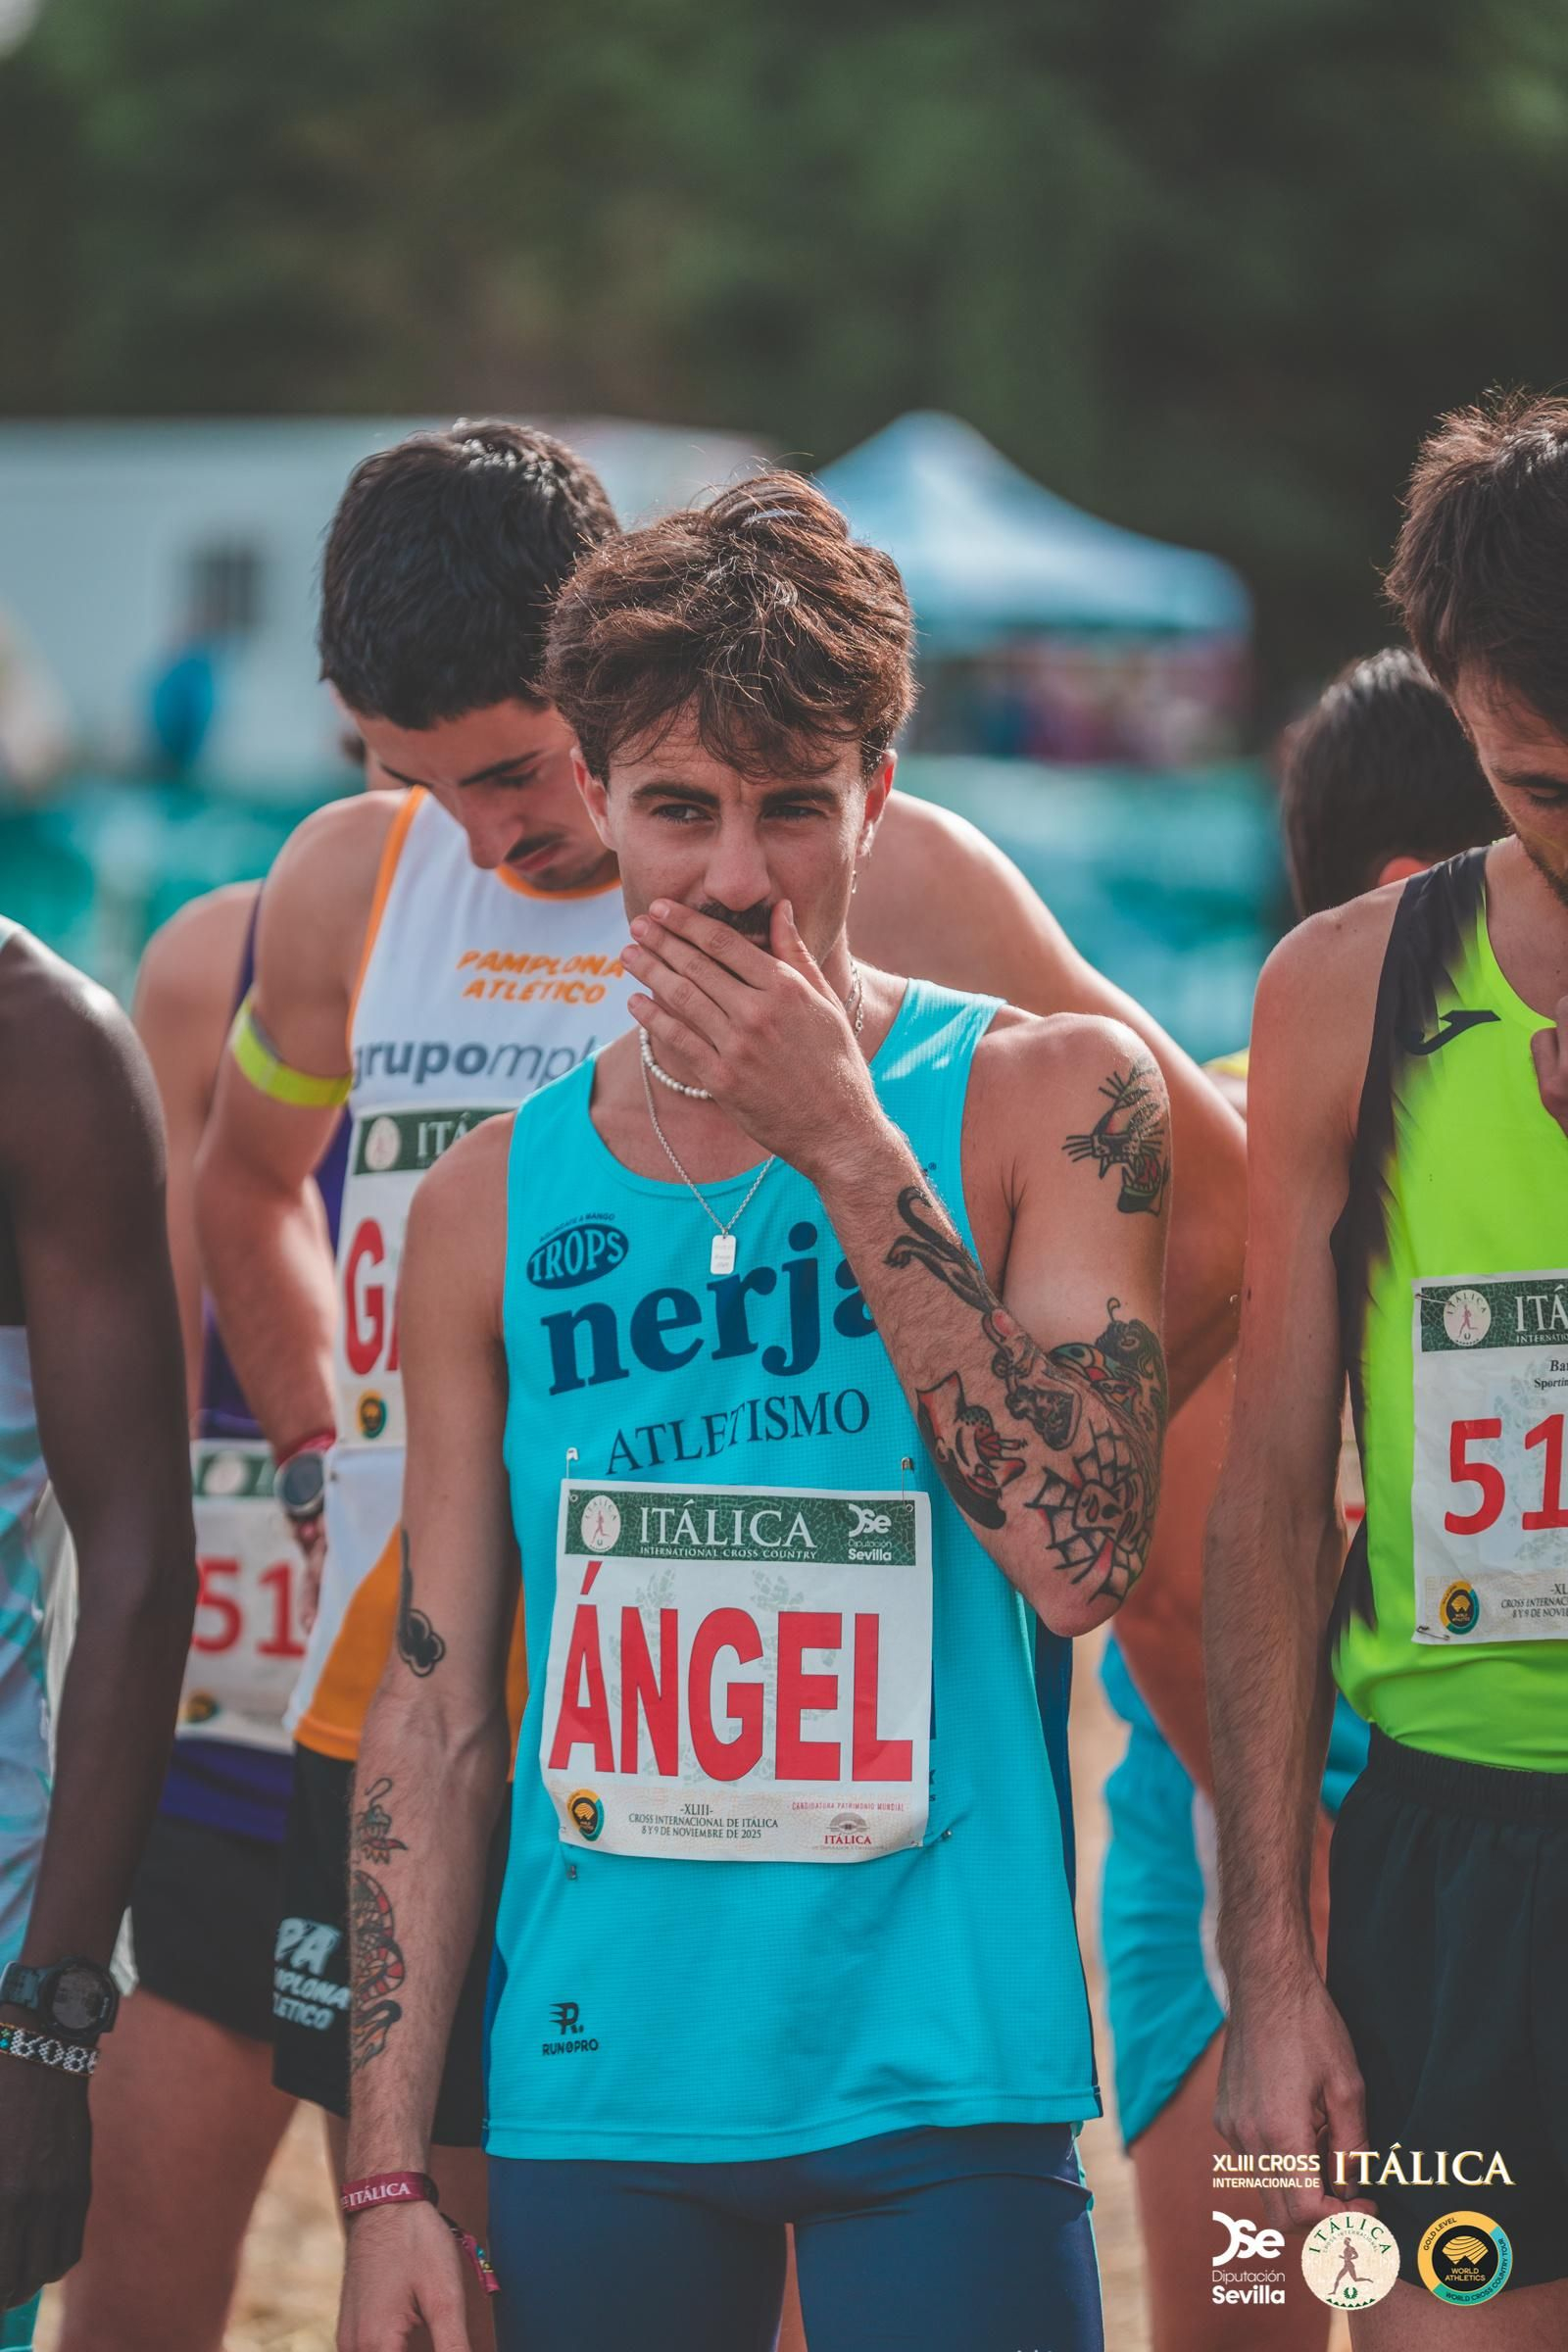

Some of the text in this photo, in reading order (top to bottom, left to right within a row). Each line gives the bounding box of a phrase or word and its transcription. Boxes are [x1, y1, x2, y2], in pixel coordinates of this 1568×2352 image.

[457, 950, 625, 978] PAMPLONA
[532, 1229, 624, 1281] TROPS
[345, 1216, 401, 1375] G
[541, 1221, 878, 1396] nerja
[1550, 1359, 1568, 1372] Ba
[606, 1389, 870, 1475] ATLETISMO
[1445, 1414, 1568, 1535] 51
[640, 1498, 817, 1548] ITÁLICA
[640, 1546, 817, 1559] INTERNATIONAL CROSS COUNTRY
[848, 1548, 892, 1561] Sevilla
[548, 1561, 913, 1782] ÁNGEL
[877, 1802, 905, 1811] MUNDIAL
[628, 1813, 654, 1824] CROSS
[655, 1815, 724, 1827] INTERNACIONAL
[727, 1819, 740, 1828] DE
[661, 1827, 671, 1836] DE
[672, 1828, 723, 1838] NOVIEMBRE
[726, 1830, 739, 1838] DE
[741, 1829, 761, 1839] 2025
[824, 1833, 871, 1844] ITÁLICA
[349, 2182, 412, 2206] ITÁLICA
